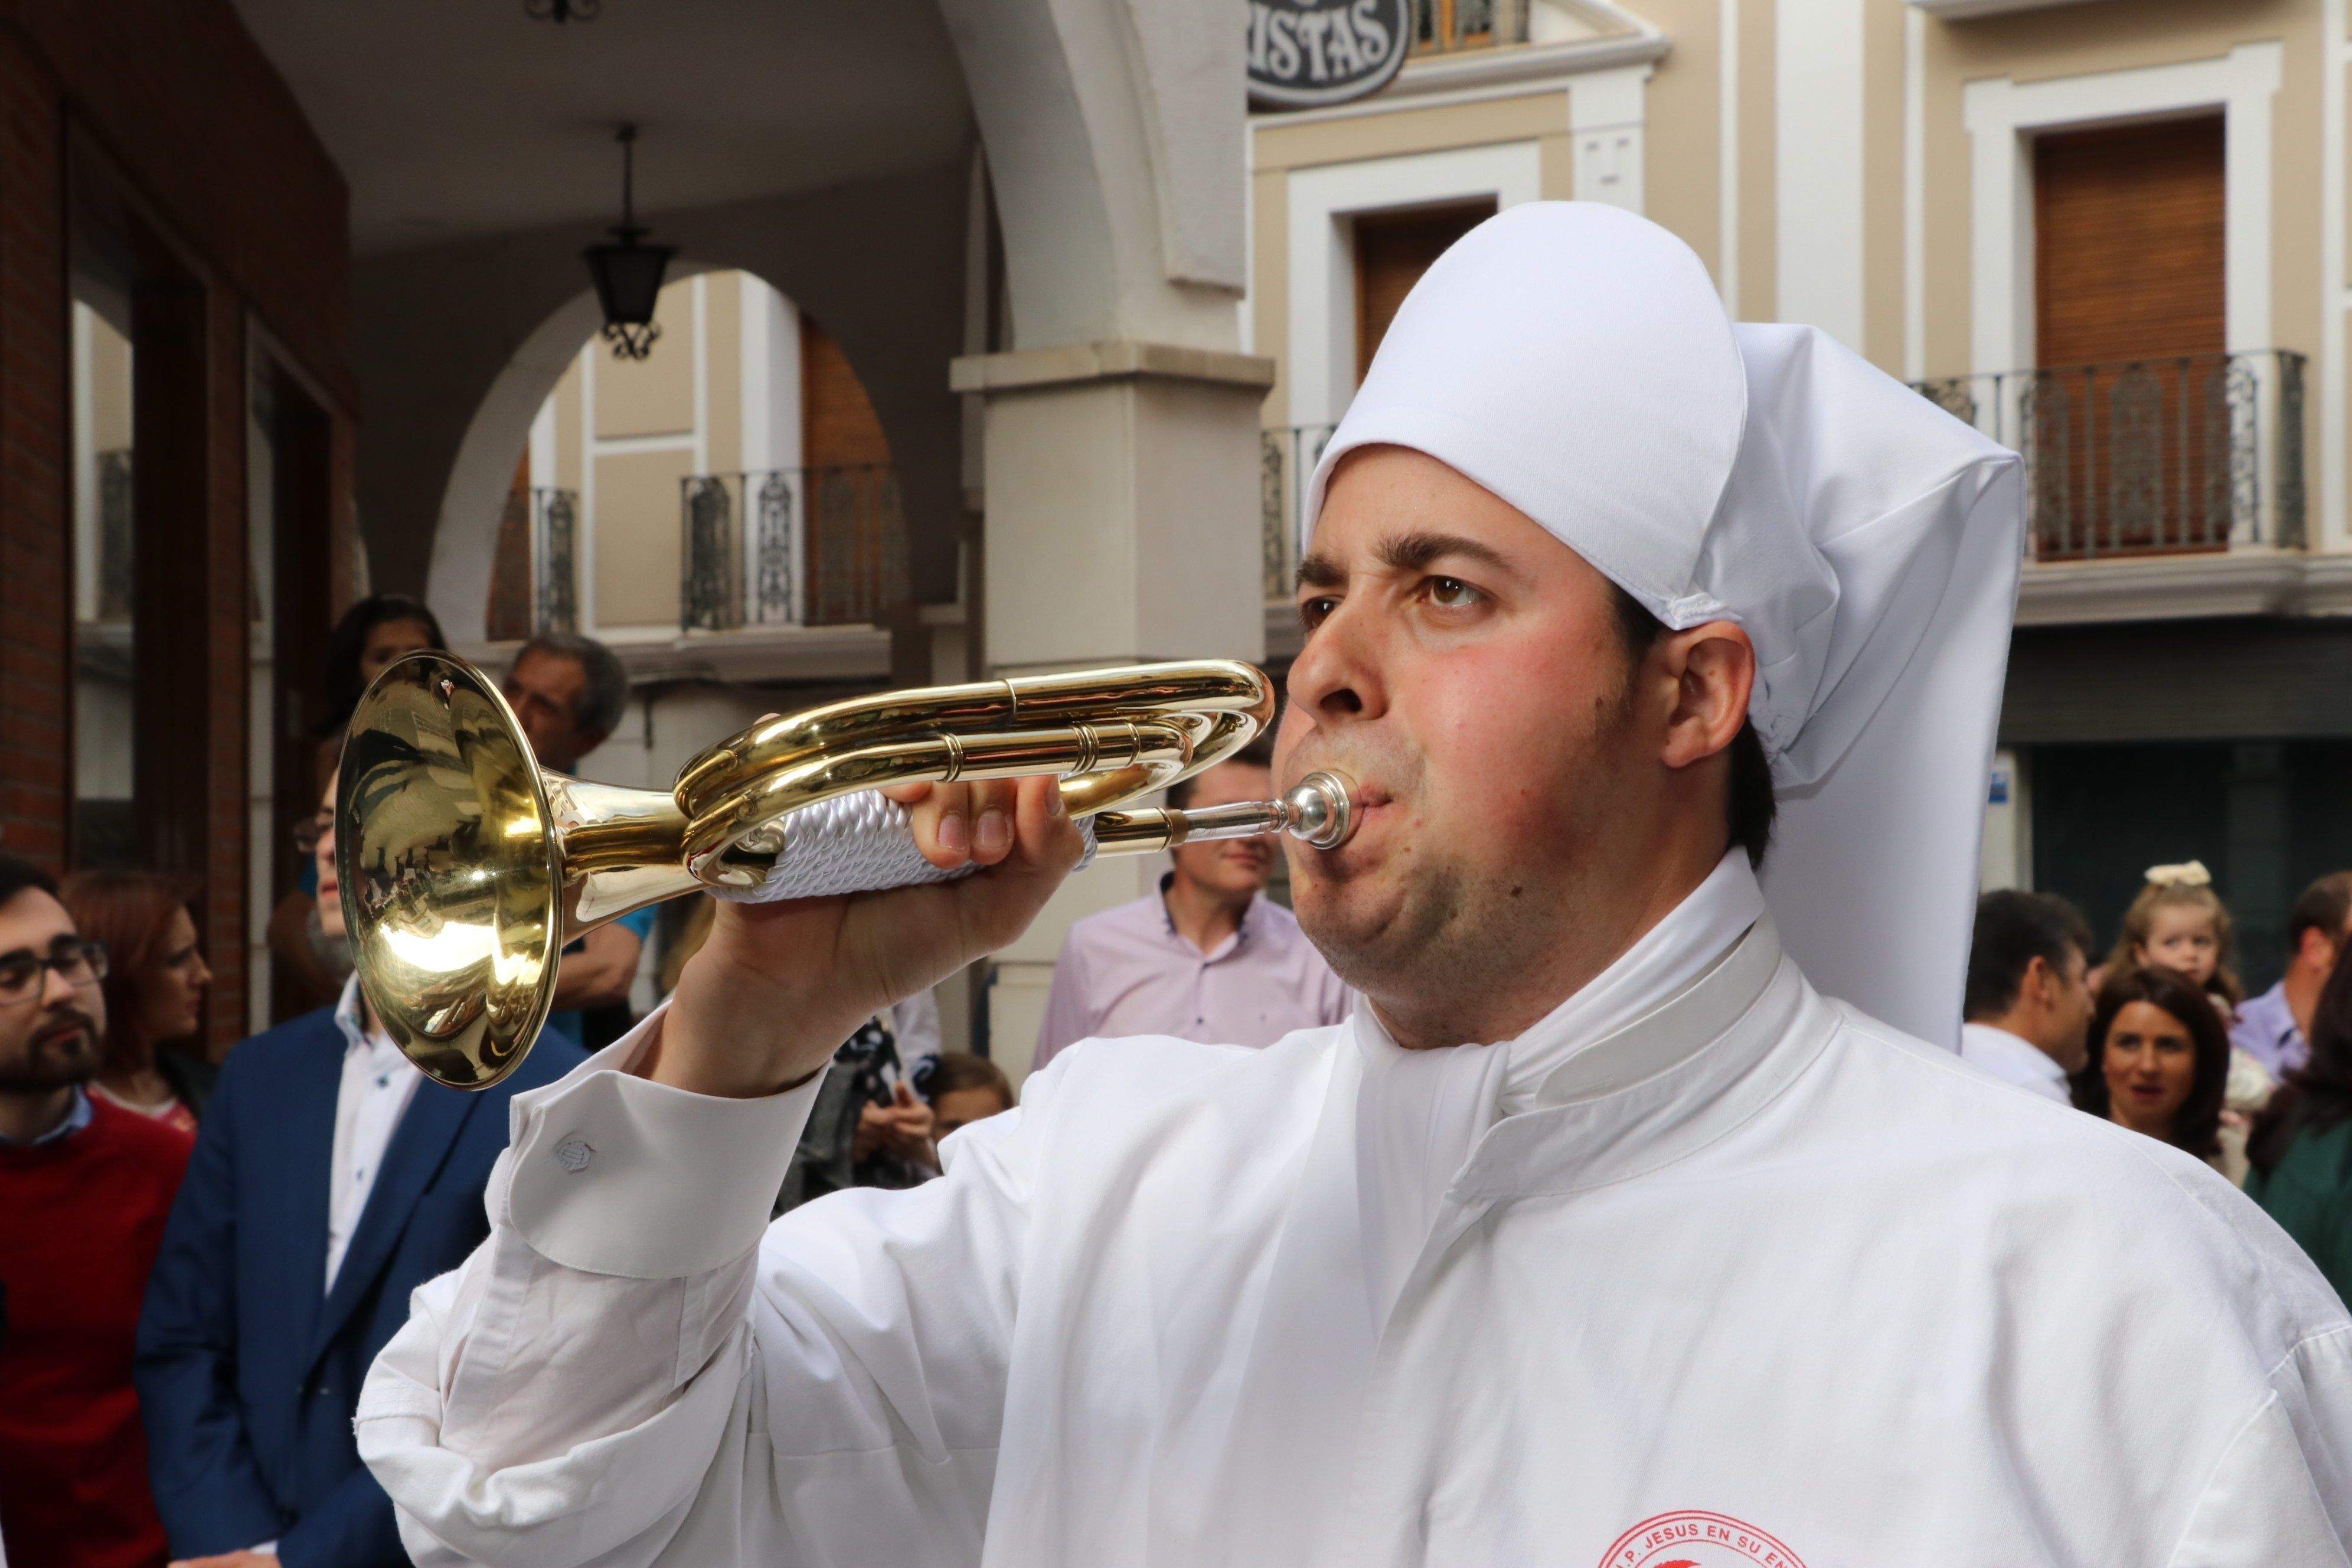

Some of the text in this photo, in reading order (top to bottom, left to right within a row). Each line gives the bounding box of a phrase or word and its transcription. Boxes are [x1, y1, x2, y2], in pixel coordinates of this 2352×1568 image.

[1645, 1524, 1698, 1549] JESUS
[1707, 1526, 1730, 1541] EN
[1737, 1536, 1761, 1553] SU
